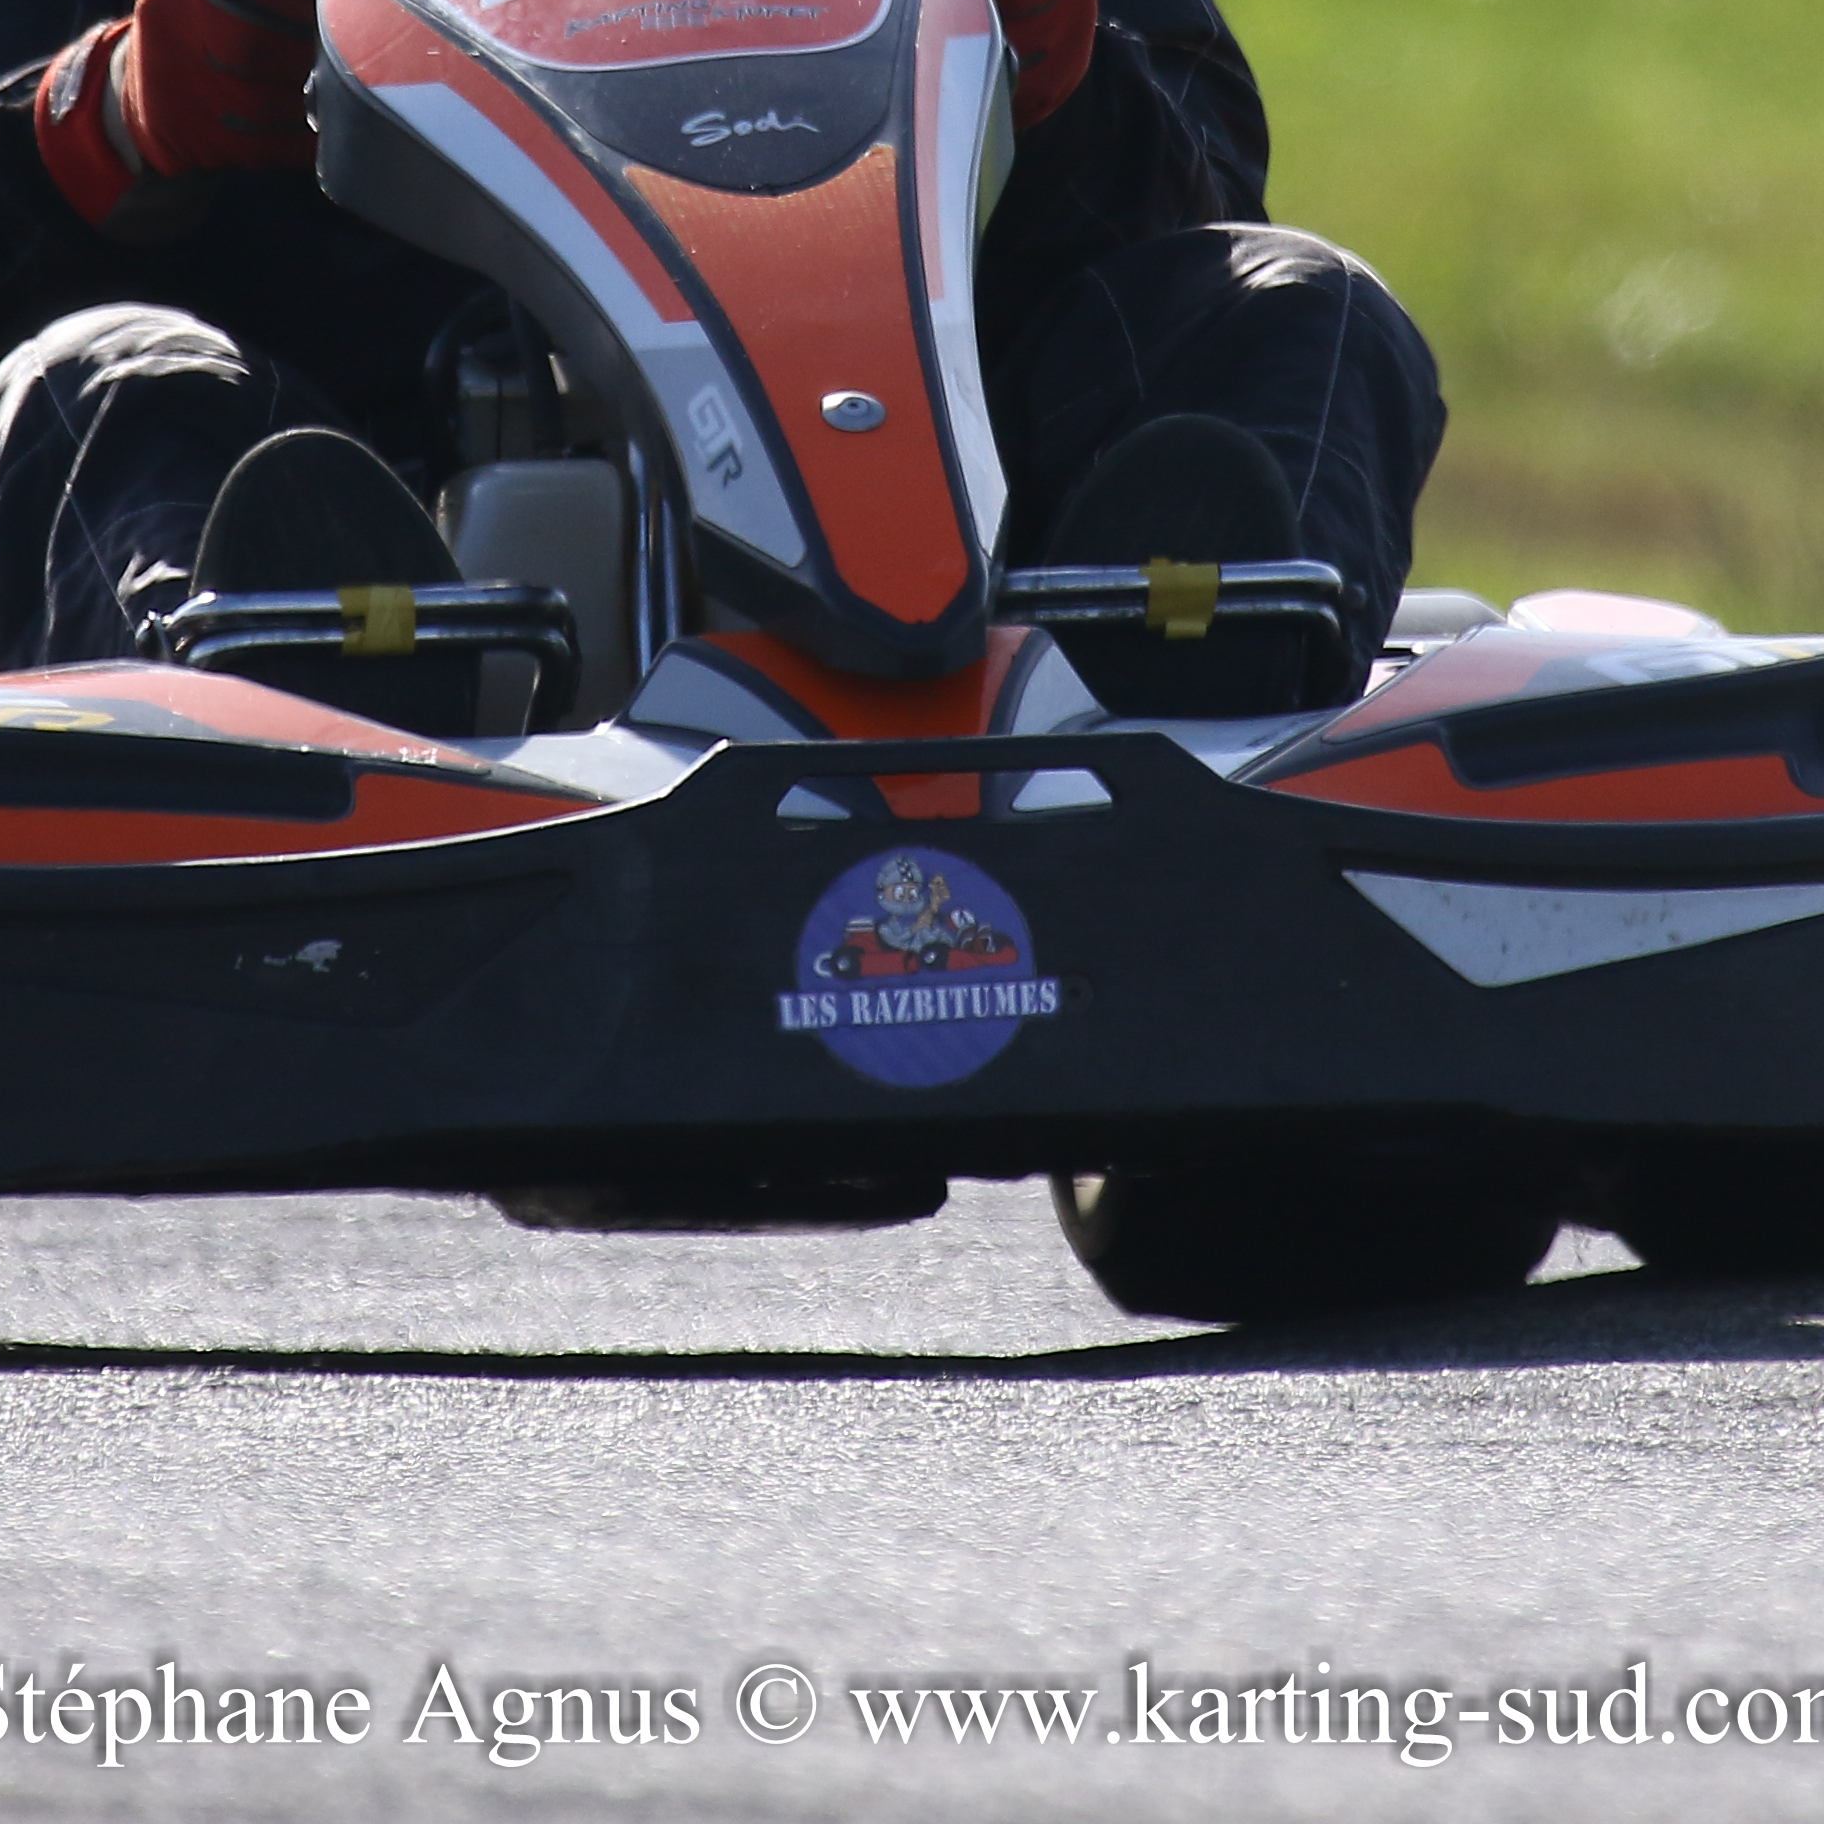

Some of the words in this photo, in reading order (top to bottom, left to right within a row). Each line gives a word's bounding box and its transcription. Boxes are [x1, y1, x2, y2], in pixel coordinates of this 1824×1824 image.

[680, 109, 822, 148] Sodi
[687, 383, 743, 489] GTR
[778, 991, 839, 1031] LES
[850, 979, 1059, 1026] RAZBITUMES
